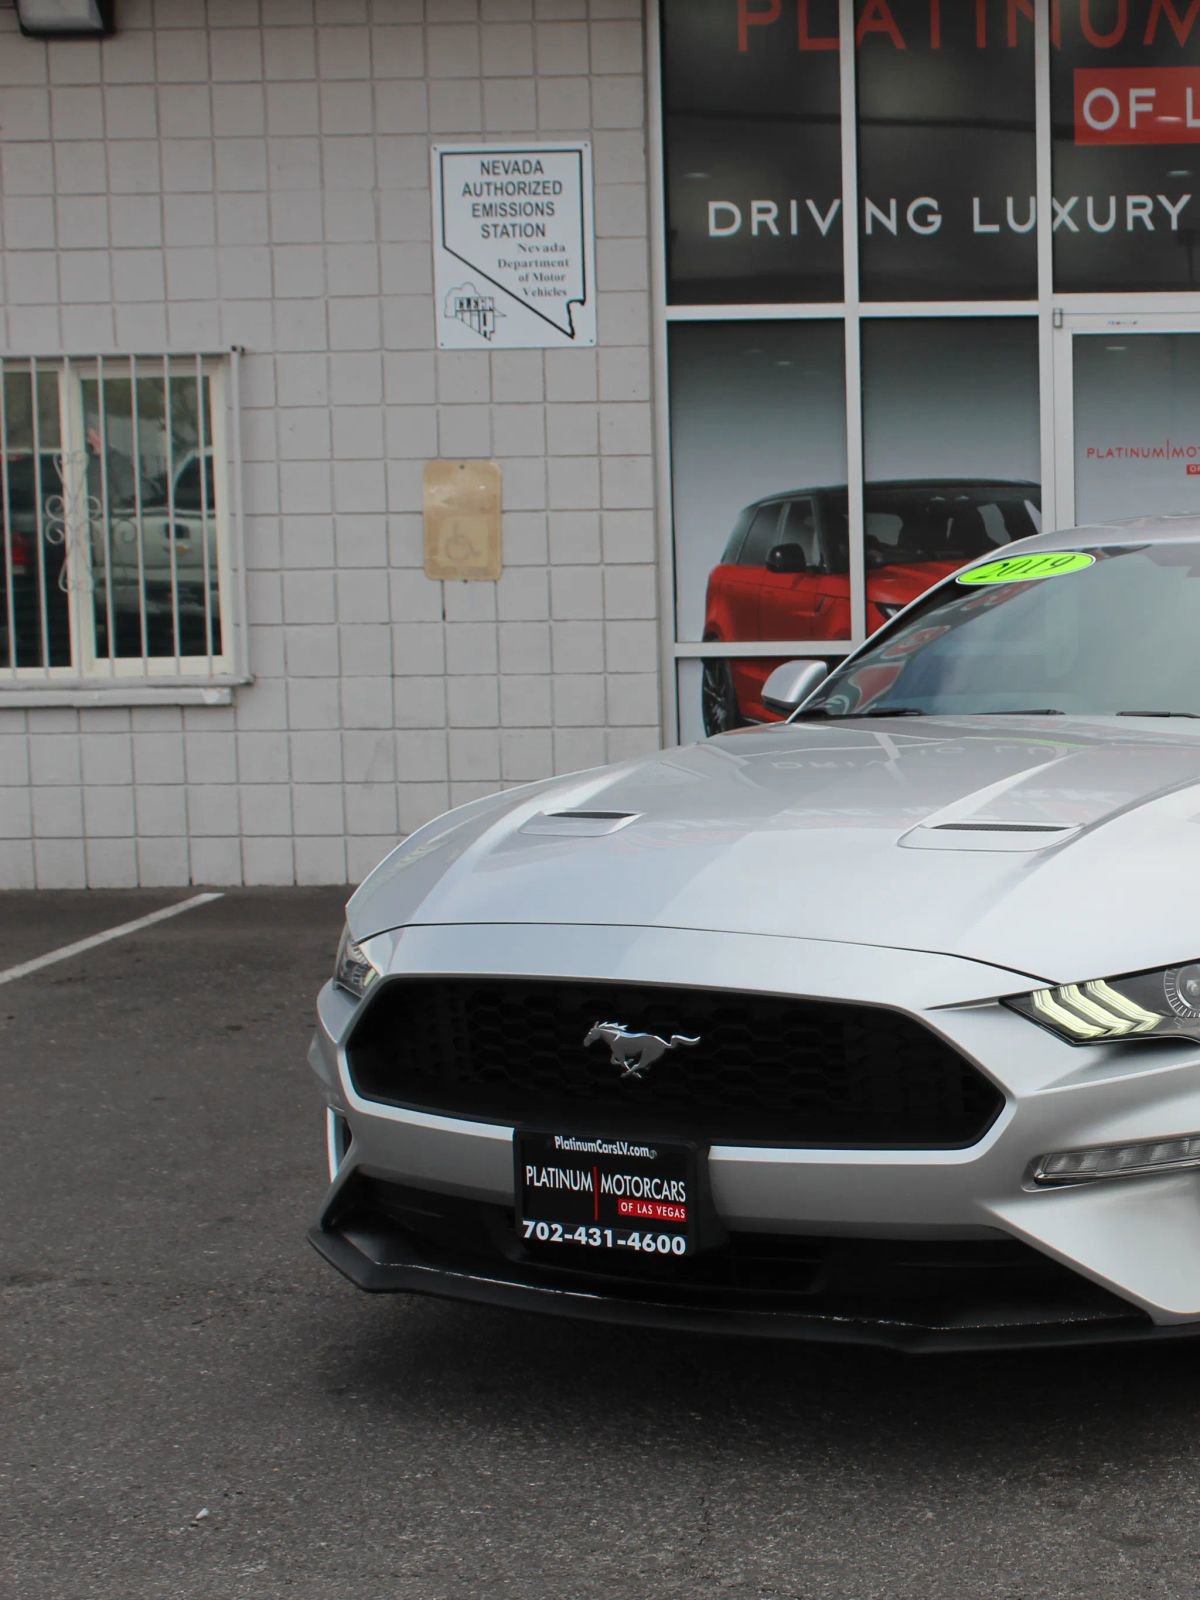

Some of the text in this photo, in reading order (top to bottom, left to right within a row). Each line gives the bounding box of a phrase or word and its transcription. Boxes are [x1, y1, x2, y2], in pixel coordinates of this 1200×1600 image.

[1083, 88, 1156, 131] OF
[480, 159, 544, 176] NEVADA
[462, 180, 563, 197] AUTHORIZED
[471, 201, 555, 218] EMISSIONS
[708, 197, 943, 238] DRIVNG
[973, 194, 1191, 233] LUXURY
[481, 223, 546, 239] STATION
[517, 243, 566, 254] Nevada
[497, 258, 569, 271] Department
[518, 271, 566, 282] of Motor
[523, 286, 567, 297] Vehicles
[1087, 446, 1165, 458] PLATINUM
[974, 554, 1077, 579] 2019
[555, 1136, 650, 1157] PlatinumCarsLV.com
[525, 1165, 686, 1202] PLATINUM MOTORCARS
[620, 1202, 686, 1219] OF LAS VEGAS
[522, 1220, 686, 1255] 702-431-4600
